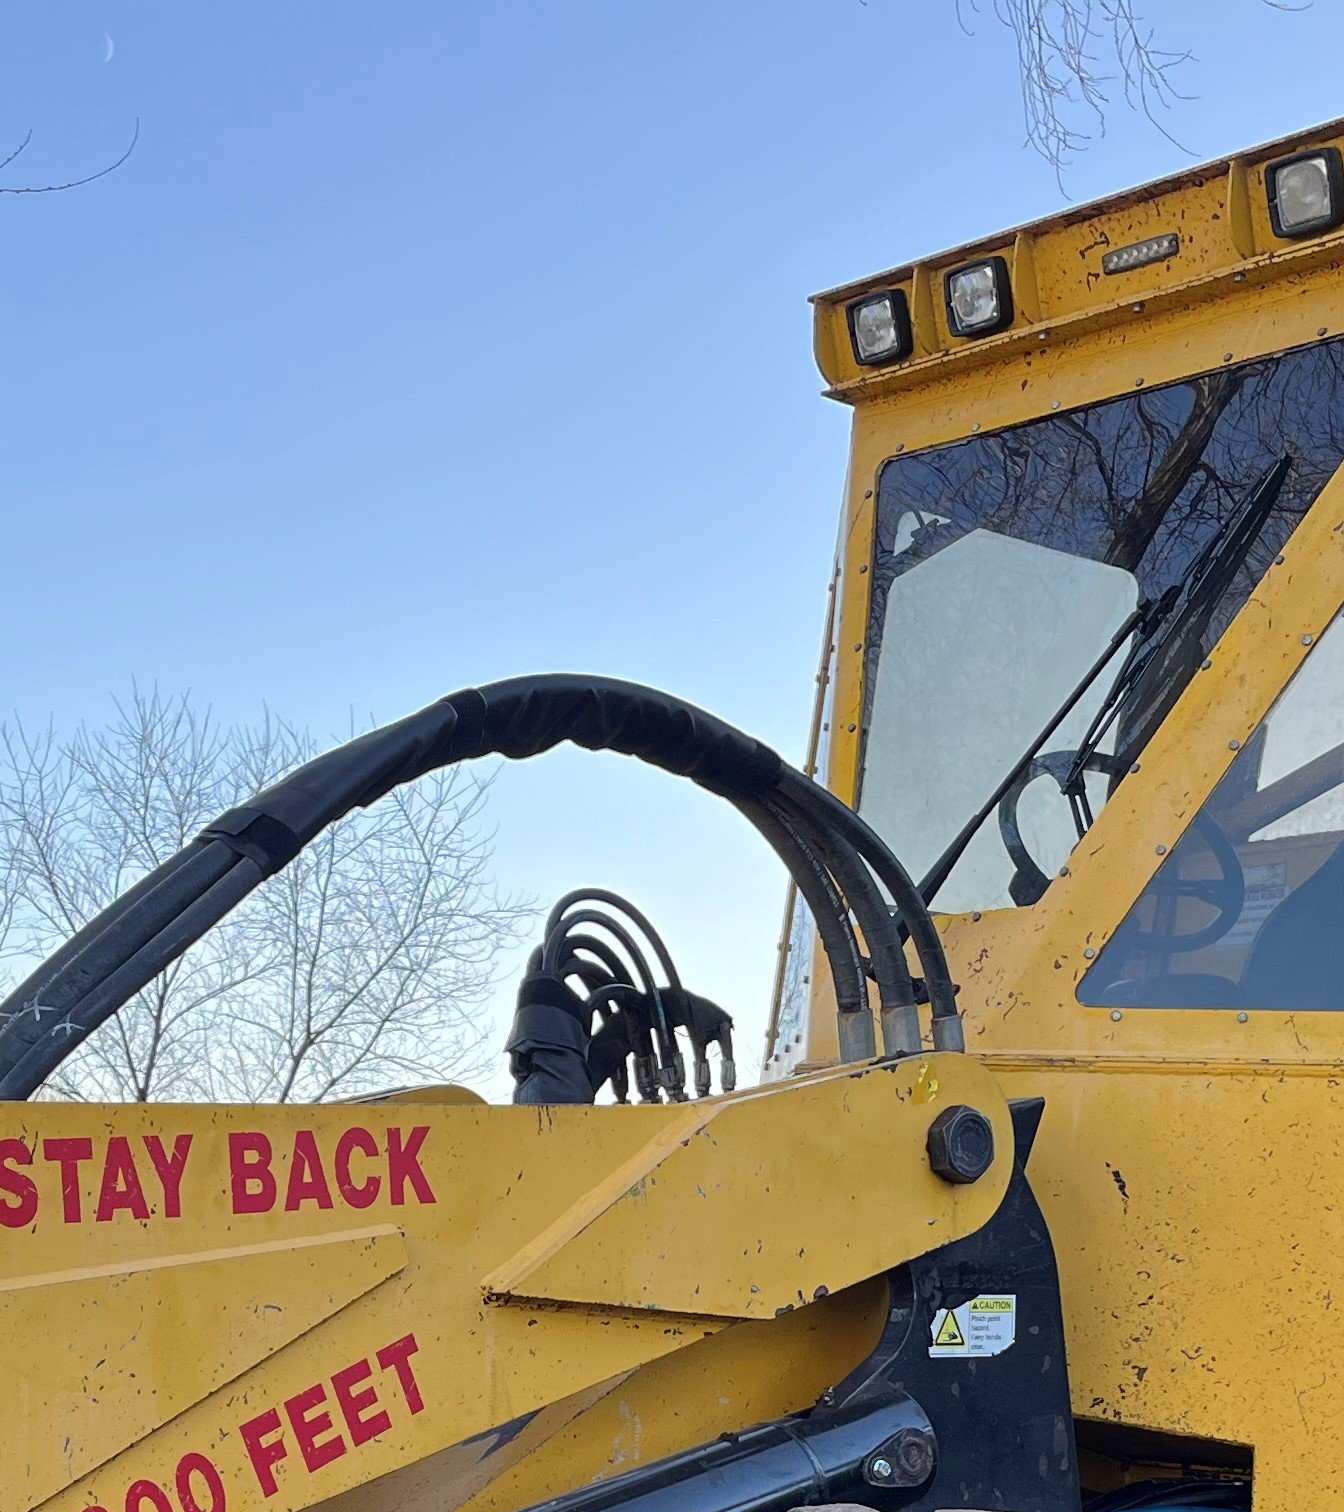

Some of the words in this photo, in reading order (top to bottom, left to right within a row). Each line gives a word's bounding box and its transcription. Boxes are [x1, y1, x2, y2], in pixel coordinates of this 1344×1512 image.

[228, 1125, 437, 1214] BACK
[979, 1300, 1011, 1310] CAUTION
[239, 1333, 426, 1499] FEET
